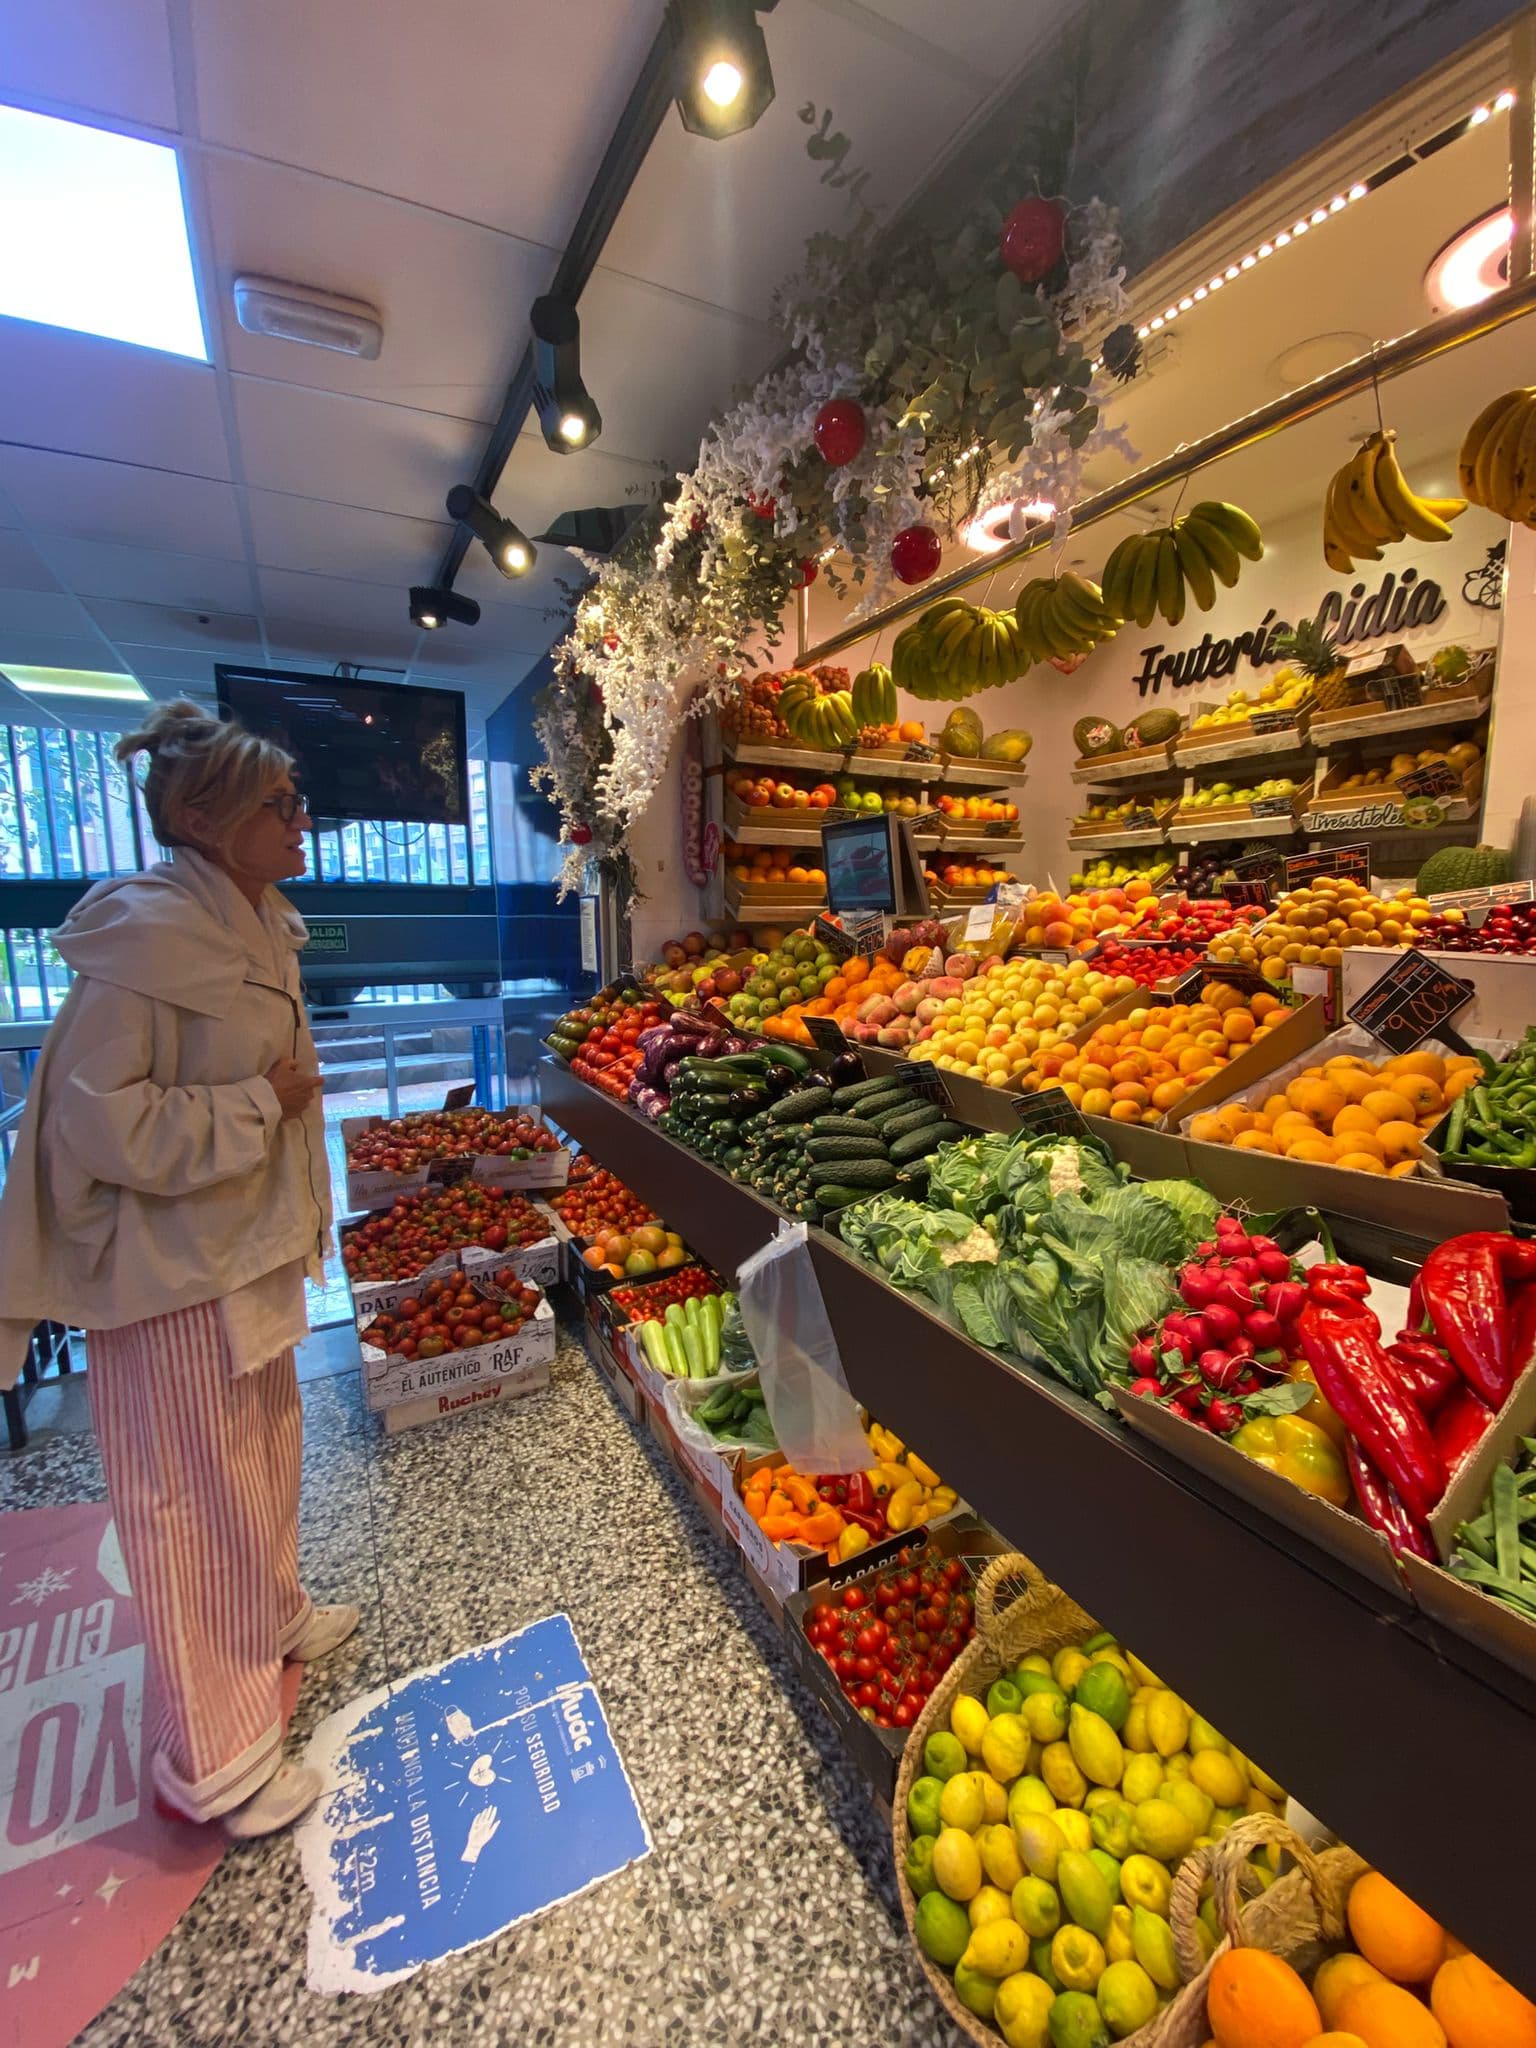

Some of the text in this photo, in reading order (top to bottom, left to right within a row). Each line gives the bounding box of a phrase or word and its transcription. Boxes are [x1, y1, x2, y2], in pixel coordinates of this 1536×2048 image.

[310, 927, 344, 937] ALIDA
[401, 1378, 415, 1393] EL
[493, 1346, 524, 1373] RAF
[45, 1598, 115, 1674] en
[520, 1713, 538, 1732] SU
[556, 1680, 594, 1752] Muác
[526, 1733, 561, 1813] SEGURIDAD
[395, 1711, 441, 1910] MANTNGA LA DISTANCIA
